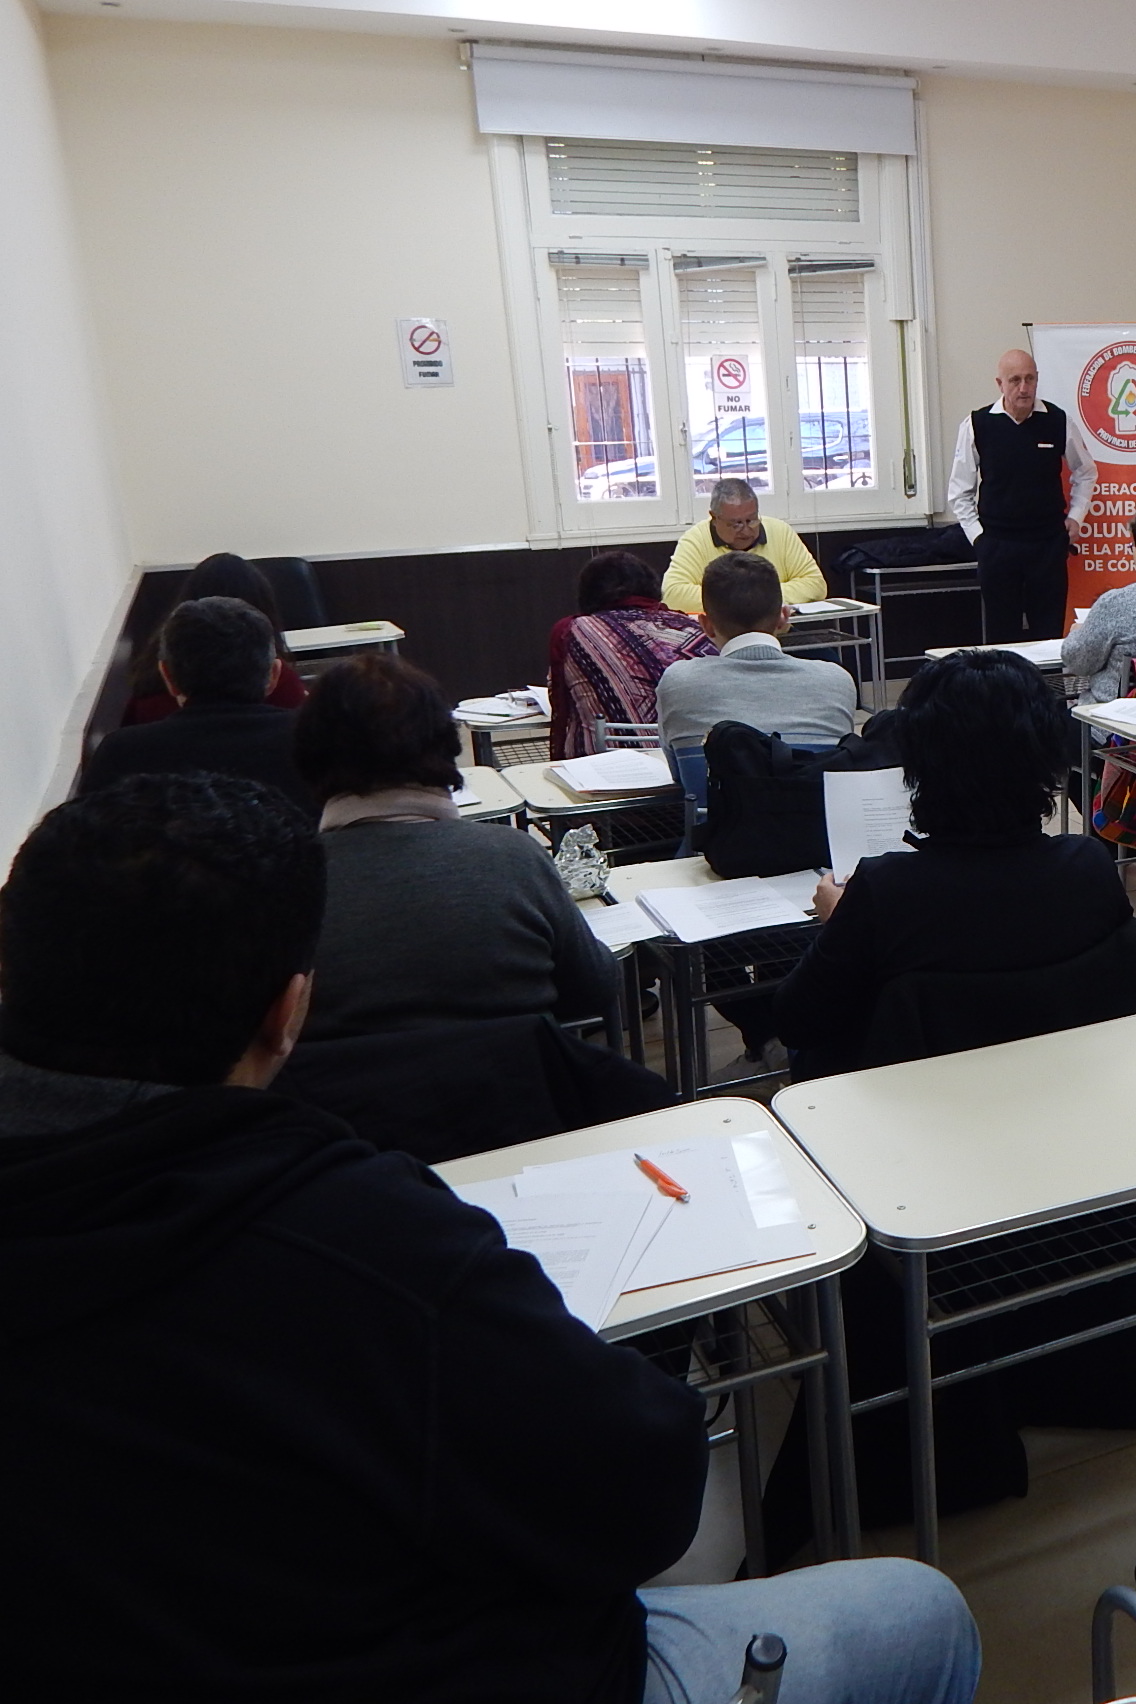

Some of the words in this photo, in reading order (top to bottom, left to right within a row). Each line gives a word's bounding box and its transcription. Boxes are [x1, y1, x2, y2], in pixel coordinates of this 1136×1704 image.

[1103, 351, 1113, 361] DE
[727, 395, 741, 403] NO
[1096, 427, 1127, 448] PROVINCIA
[1128, 440, 1136, 449] DE
[1093, 543, 1111, 555] LA
[1084, 559, 1104, 571] DE
